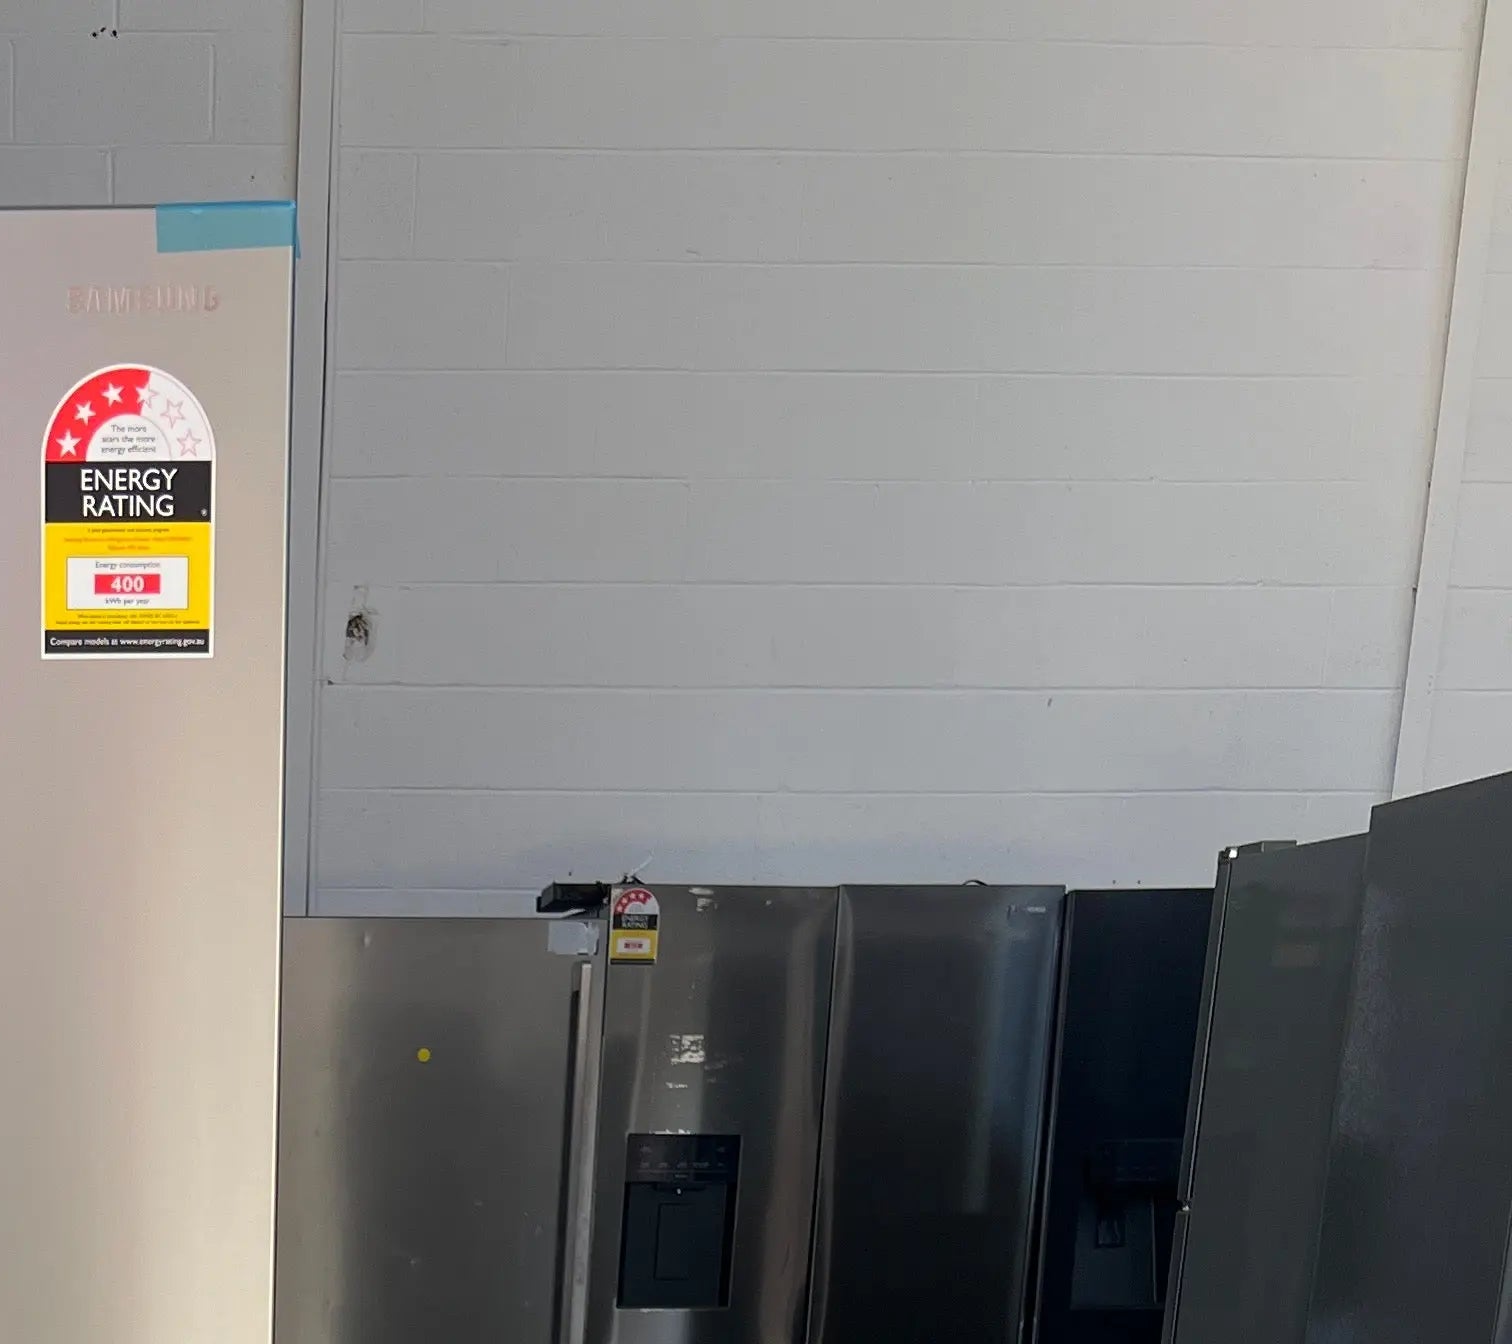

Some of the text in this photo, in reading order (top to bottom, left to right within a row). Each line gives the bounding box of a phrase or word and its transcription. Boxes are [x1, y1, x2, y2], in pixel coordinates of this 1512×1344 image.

[80, 467, 178, 492] ENERGY
[82, 494, 175, 518] RATING
[95, 561, 117, 570] Energy
[110, 575, 145, 593] 400
[49, 636, 83, 648] Compare
